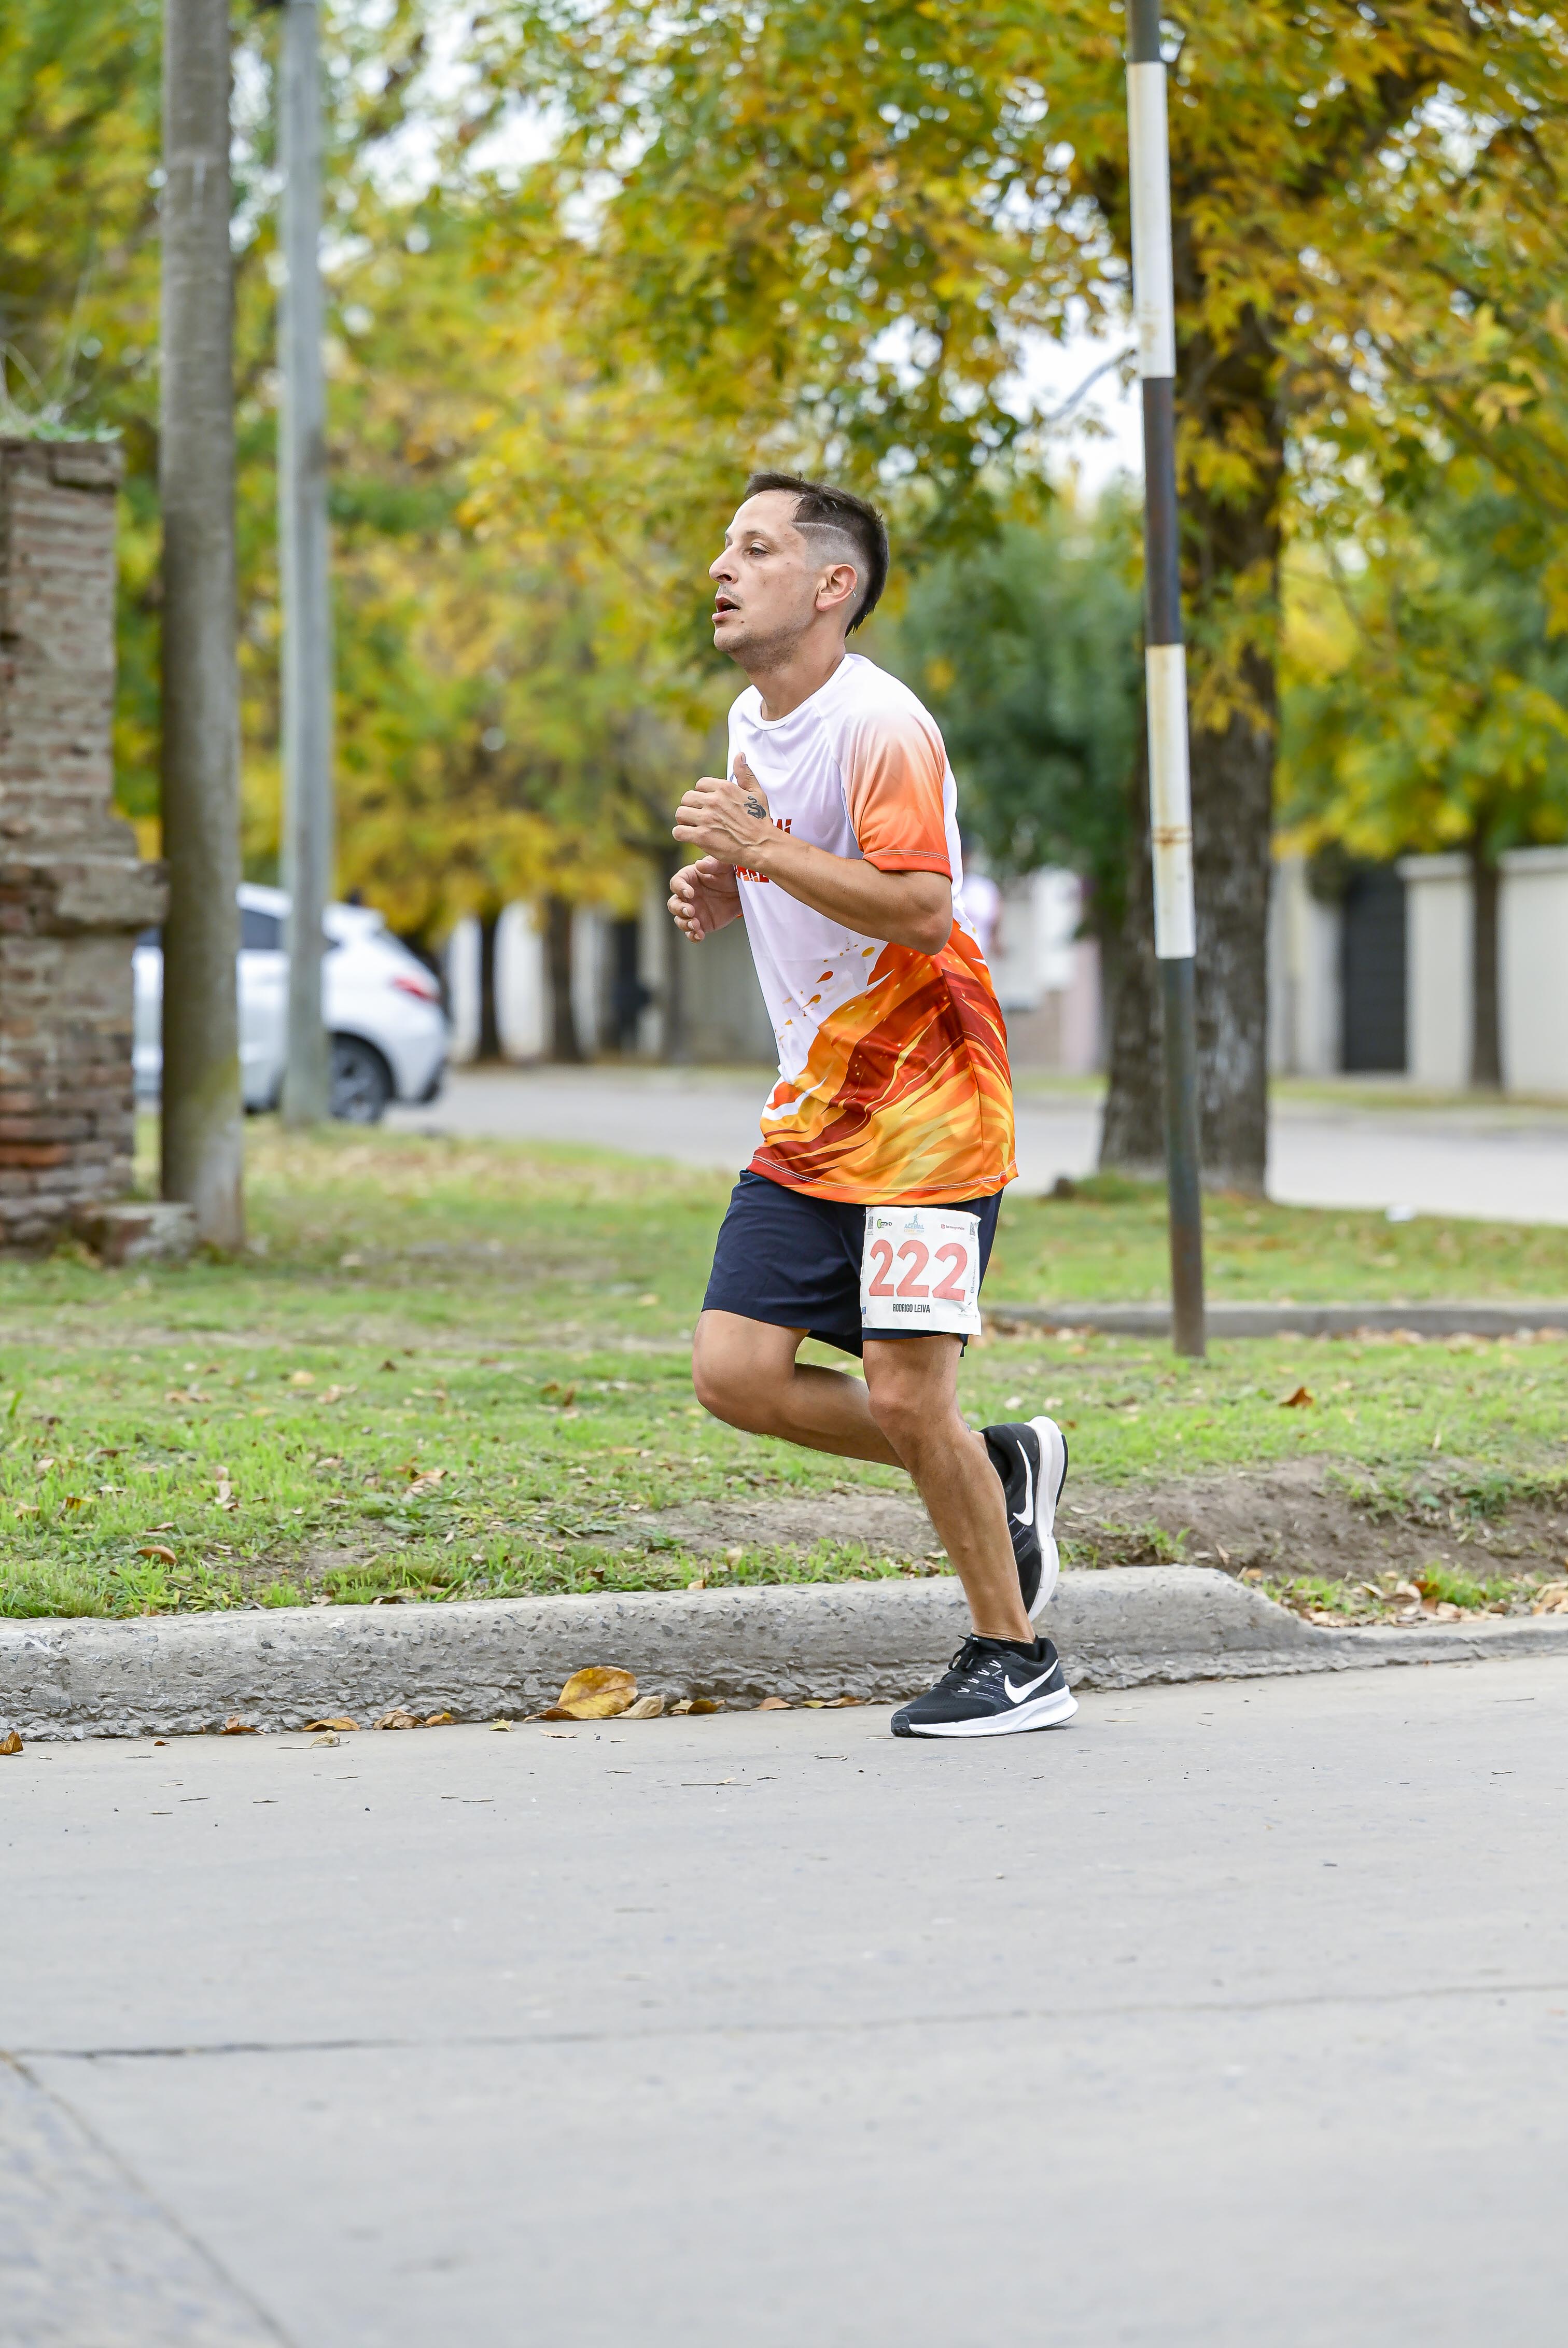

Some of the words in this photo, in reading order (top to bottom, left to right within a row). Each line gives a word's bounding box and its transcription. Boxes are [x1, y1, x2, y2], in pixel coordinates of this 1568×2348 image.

[869, 1239, 968, 1302] 222
[892, 1304, 913, 1312] RODRIGO
[914, 1304, 930, 1313] LEIVA
